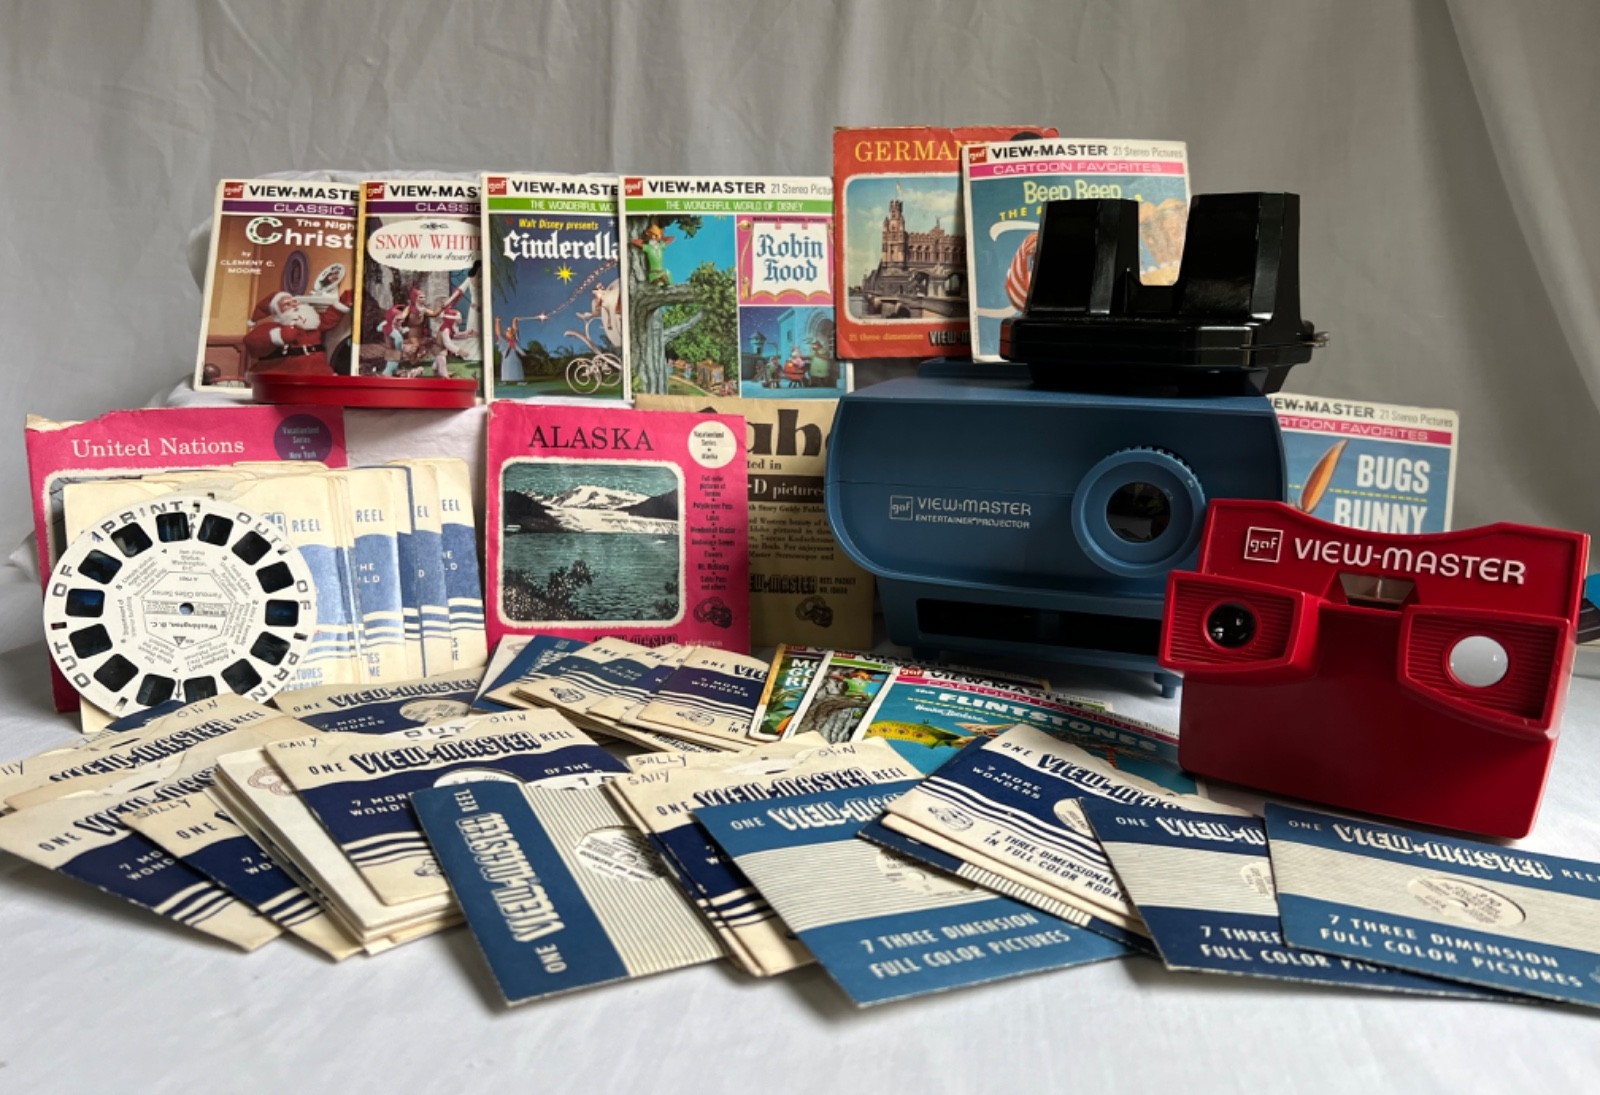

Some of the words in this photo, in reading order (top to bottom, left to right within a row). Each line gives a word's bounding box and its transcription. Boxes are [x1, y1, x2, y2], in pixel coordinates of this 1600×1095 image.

[855, 141, 990, 162] GERMAN
[992, 145, 1108, 159] VIEW-MASTER
[1124, 146, 1150, 157] Stereo
[993, 162, 1072, 175] CARTOON
[1080, 161, 1162, 174] FAVORITES
[390, 185, 481, 198] VIEW-MAS
[488, 181, 506, 192] gaf
[649, 181, 766, 194] VIEW-MASTER
[771, 184, 780, 194] 21
[783, 184, 808, 195] Stereo
[273, 203, 345, 215] CLASSIC
[531, 201, 545, 209] THE
[551, 201, 596, 211] WONDERFUL
[666, 201, 680, 210] THE
[684, 201, 730, 212] WONDERFUL
[734, 201, 762, 212] WORLD
[764, 201, 774, 211] OF
[777, 202, 804, 212] DISNEY
[1000, 207, 1027, 221] THE
[296, 219, 321, 228] The
[518, 218, 536, 229] Walt
[538, 219, 564, 231] Disney
[566, 220, 599, 231] presents
[375, 234, 422, 250] SNOW
[755, 233, 824, 260] Robin
[405, 251, 417, 260] the
[1268, 397, 1375, 418] EW-MASTER
[1379, 408, 1389, 420] 21
[1392, 410, 1418, 424] Stereo
[1420, 413, 1453, 428] Pictures
[528, 425, 655, 451] ALASKA
[1340, 421, 1428, 442] FAVORITES
[70, 438, 151, 458] United
[159, 436, 245, 456] Nations
[769, 459, 782, 470] in
[1357, 454, 1430, 494] BUGS
[356, 509, 385, 523] REEL
[891, 502, 911, 515] gaf
[917, 497, 1032, 516] VIEW-MASTER
[1335, 498, 1428, 534] BUNNY
[101, 499, 184, 536] PRINT
[291, 519, 322, 532] REEL
[1250, 535, 1278, 552] gaf
[1294, 537, 1527, 585] VIEW-MASTER
[51, 563, 75, 599] OF
[296, 579, 313, 612] OF
[53, 640, 92, 689] OUT
[701, 659, 726, 669] ONE
[691, 679, 749, 697] WONDERS
[713, 679, 746, 691] MORE
[925, 679, 1032, 704] CARTOON
[292, 702, 322, 712] ONE
[230, 710, 266, 726] REEL
[336, 715, 375, 727] MORE
[938, 692, 1157, 752] FLINTSTONES
[403, 725, 466, 740] OUT
[307, 762, 347, 776] ONE
[349, 731, 541, 776] VIEW-MASTER
[541, 730, 574, 743] REEL
[1001, 741, 1034, 758] ONE
[544, 766, 561, 776] OF
[564, 762, 592, 773] THE
[635, 753, 688, 767] SALLY
[656, 801, 692, 816] ONE
[692, 765, 876, 809] VIEW-MASTER
[871, 766, 909, 780] REEL
[971, 766, 1042, 800] WONDERS
[1000, 770, 1043, 792] MORE
[132, 799, 193, 819] SALLY
[452, 788, 480, 813] REEL
[176, 821, 219, 840] ONE
[730, 815, 767, 831] ONE
[1115, 816, 1150, 828] ONE
[38, 831, 82, 851] ONE
[1287, 819, 1323, 832] ONE
[1332, 822, 1555, 881] VIEW-MASTER
[983, 836, 1000, 846] IN
[1005, 845, 1034, 862] FULL
[1038, 860, 1079, 882] COLOR
[1004, 835, 1038, 852] THREE
[1039, 850, 1116, 887] DIMENSIONAL
[455, 811, 566, 943] VIEW-MASTER
[860, 938, 875, 955] 7
[877, 928, 939, 952] THREE
[941, 912, 1040, 940] DIMENSION
[1200, 924, 1212, 939] 7
[1219, 927, 1282, 945] THREE
[1328, 913, 1341, 926] 7
[1350, 918, 1418, 941] THREE
[1430, 933, 1560, 969] DIMENSION
[534, 942, 569, 974] ONE
[869, 961, 922, 981] FULL
[922, 943, 986, 968] COLOR
[988, 929, 1072, 956] PICTURES
[1199, 943, 1253, 962] FULL
[1260, 949, 1331, 969] COLOR
[1319, 928, 1374, 949] FULL
[1383, 940, 1459, 966] COLOR
[1471, 956, 1584, 989] PICTURES
